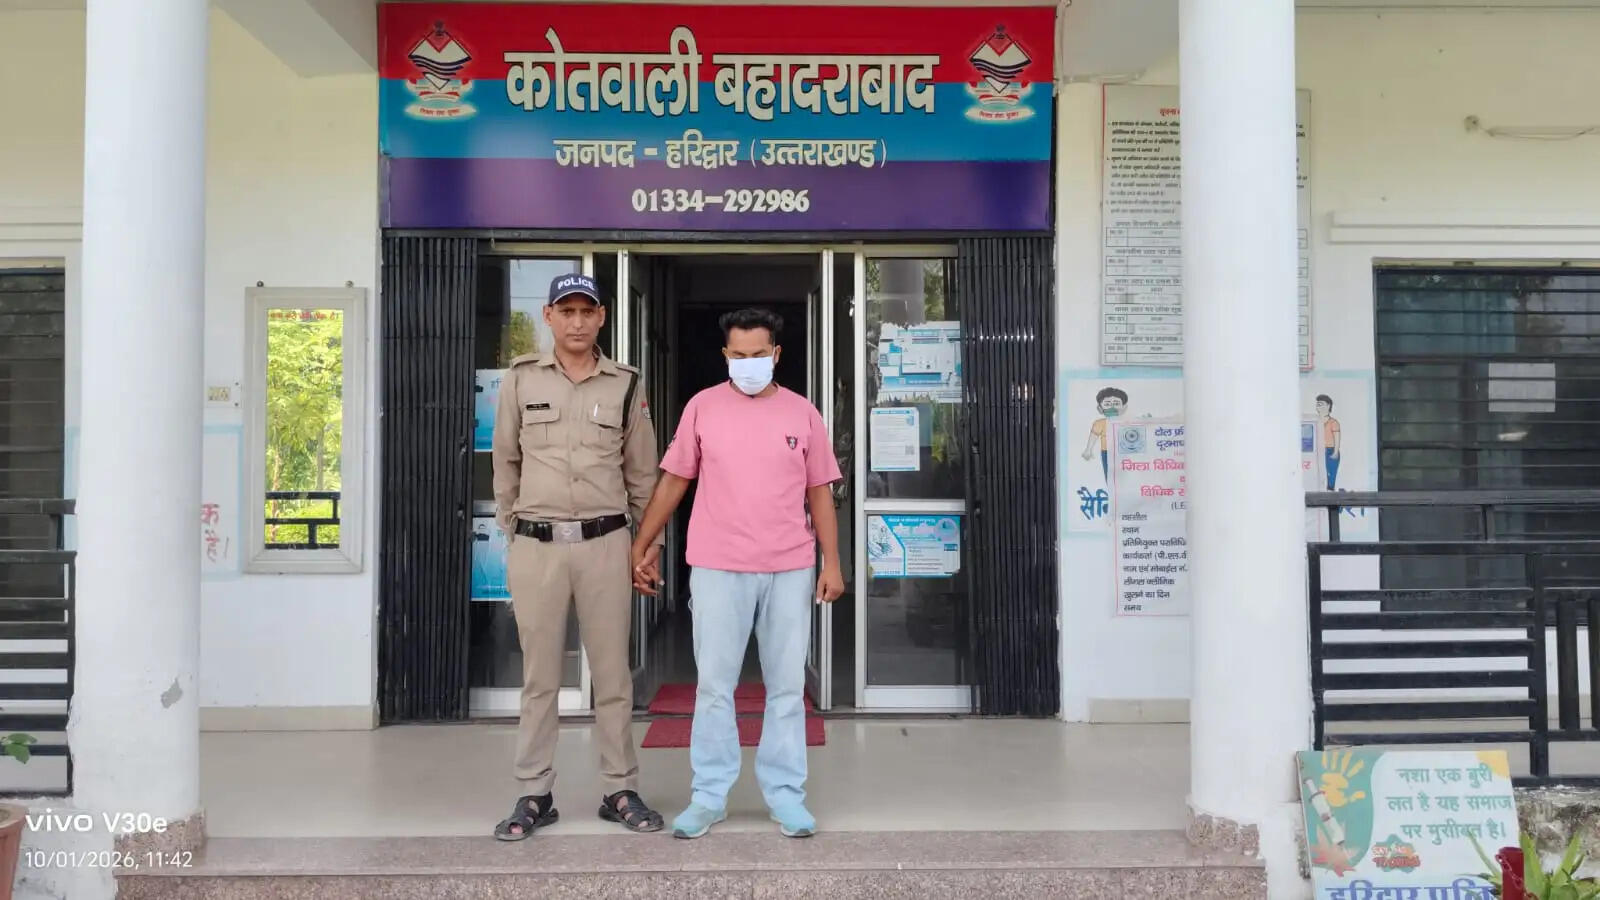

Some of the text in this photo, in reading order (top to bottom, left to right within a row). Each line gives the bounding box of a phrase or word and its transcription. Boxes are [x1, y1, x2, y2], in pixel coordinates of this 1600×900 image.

[504, 25, 940, 121] कोतवाली बहादराबाद
[553, 138, 637, 169] जनपद
[664, 128, 738, 170] हरिद्वार
[632, 188, 811, 214] 01334-292986
[558, 277, 596, 291] POLICE
[1121, 458, 1150, 471] जिला
[1395, 763, 1492, 789] नशा एक बुरी
[1385, 792, 1513, 812] लत है यह समाज
[1400, 824, 1421, 838] पर
